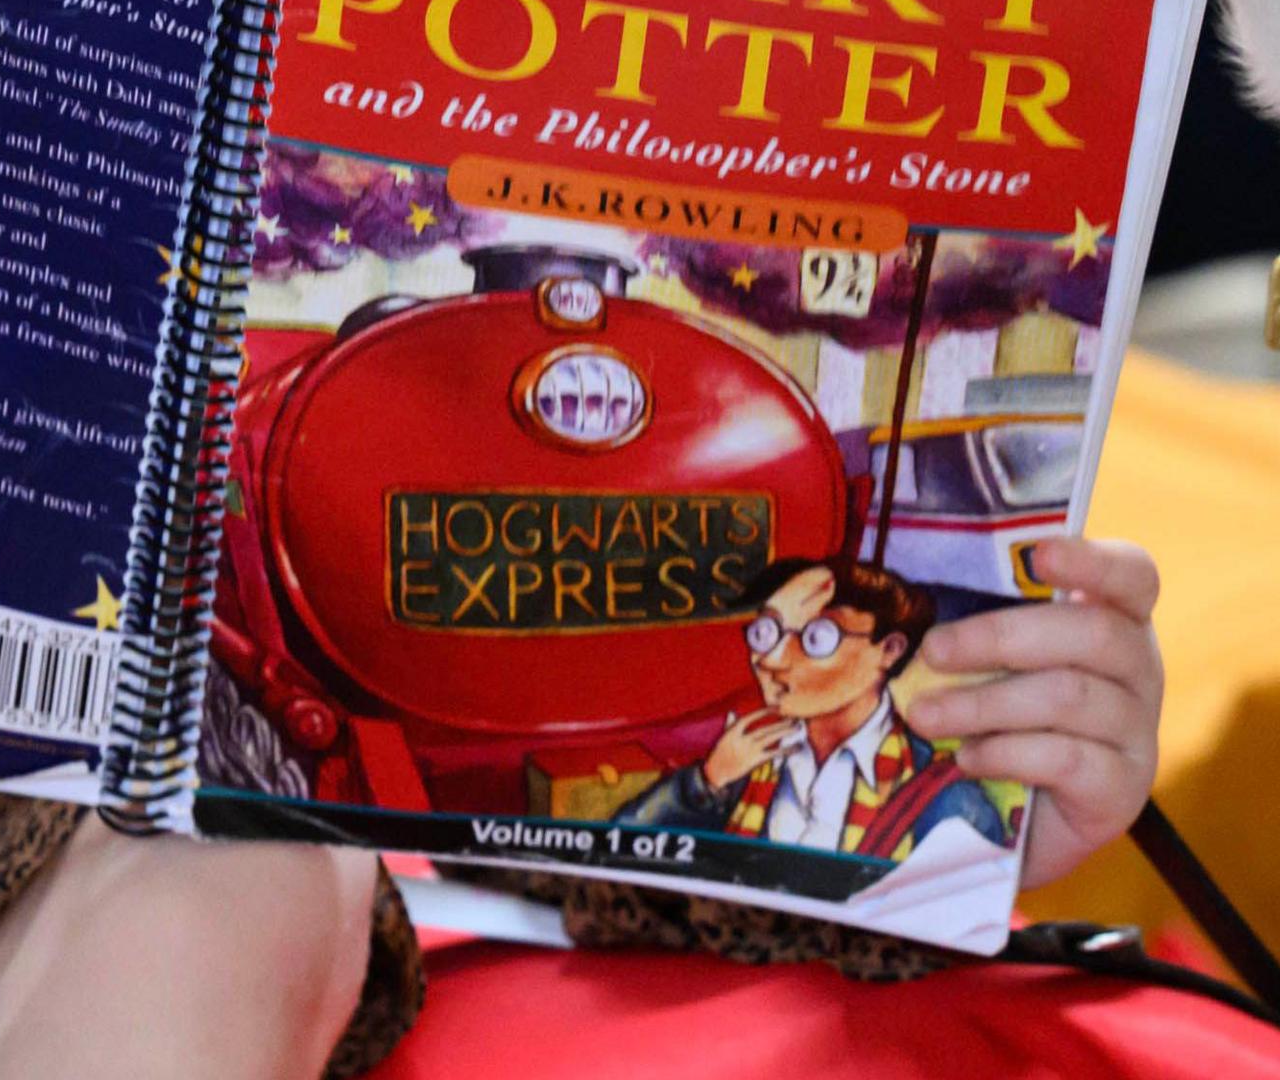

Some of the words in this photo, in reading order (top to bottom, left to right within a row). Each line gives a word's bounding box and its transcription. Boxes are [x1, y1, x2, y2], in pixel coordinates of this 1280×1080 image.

[149, 10, 205, 47] Ston
[16, 19, 49, 46] full
[55, 34, 77, 53] of
[79, 42, 162, 80] surprises
[167, 68, 203, 95] and
[56, 68, 98, 94] with
[106, 79, 152, 109] Dahl
[58, 95, 90, 122] The
[6, 132, 41, 154] and
[49, 142, 79, 165] the
[324, 83, 423, 117] and
[441, 94, 517, 135] the
[539, 110, 870, 181] Philosopher's
[891, 156, 1029, 194] Stone
[0, 161, 80, 198] makings
[87, 187, 109, 205] of
[111, 196, 121, 211] a
[2, 193, 40, 217] uses
[47, 205, 105, 237] classic
[10, 229, 47, 251] and
[16, 294, 38, 312] of
[40, 302, 51, 316] a
[76, 281, 112, 303] and
[0, 322, 10, 336] a
[17, 322, 99, 362] first-rate
[0, 476, 35, 503] first
[400, 497, 761, 557] HOGWARTS
[400, 558, 748, 622] EXPRESS
[474, 821, 592, 848] Volume
[606, 829, 620, 853] 1
[634, 833, 667, 857] of
[677, 836, 694, 860] 2
